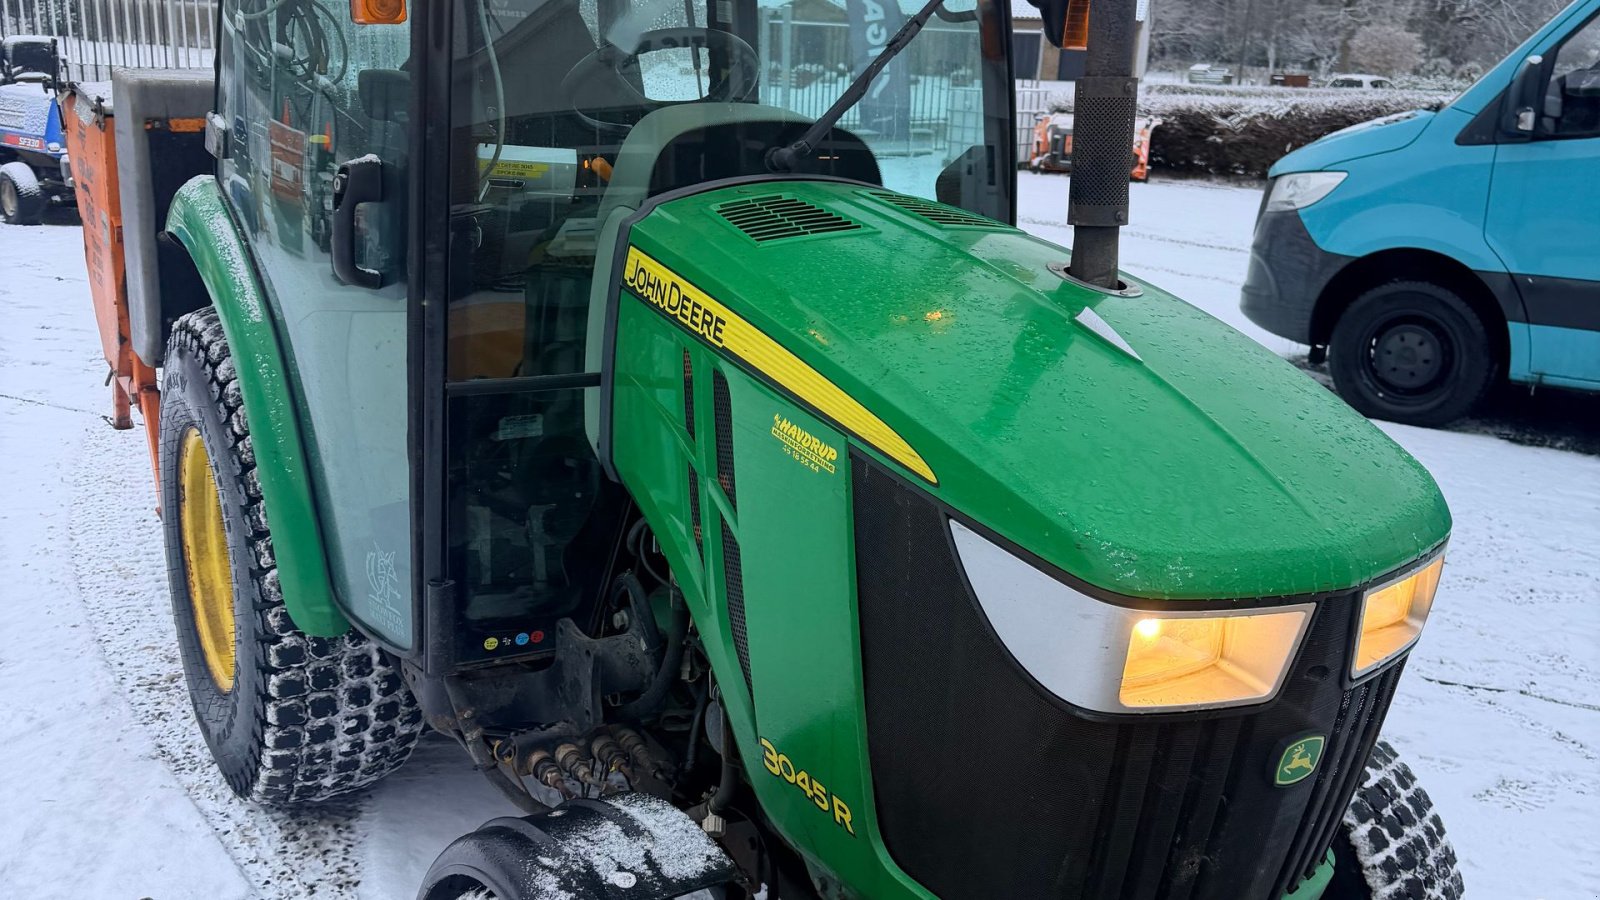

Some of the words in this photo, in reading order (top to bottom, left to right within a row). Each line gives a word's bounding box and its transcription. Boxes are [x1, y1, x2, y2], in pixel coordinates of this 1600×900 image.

[19, 136, 40, 148] SF330
[629, 259, 667, 306] JOHN
[667, 281, 726, 344] DEERE
[810, 463, 819, 473] 44
[760, 736, 829, 812] 3045
[830, 792, 856, 838] R
